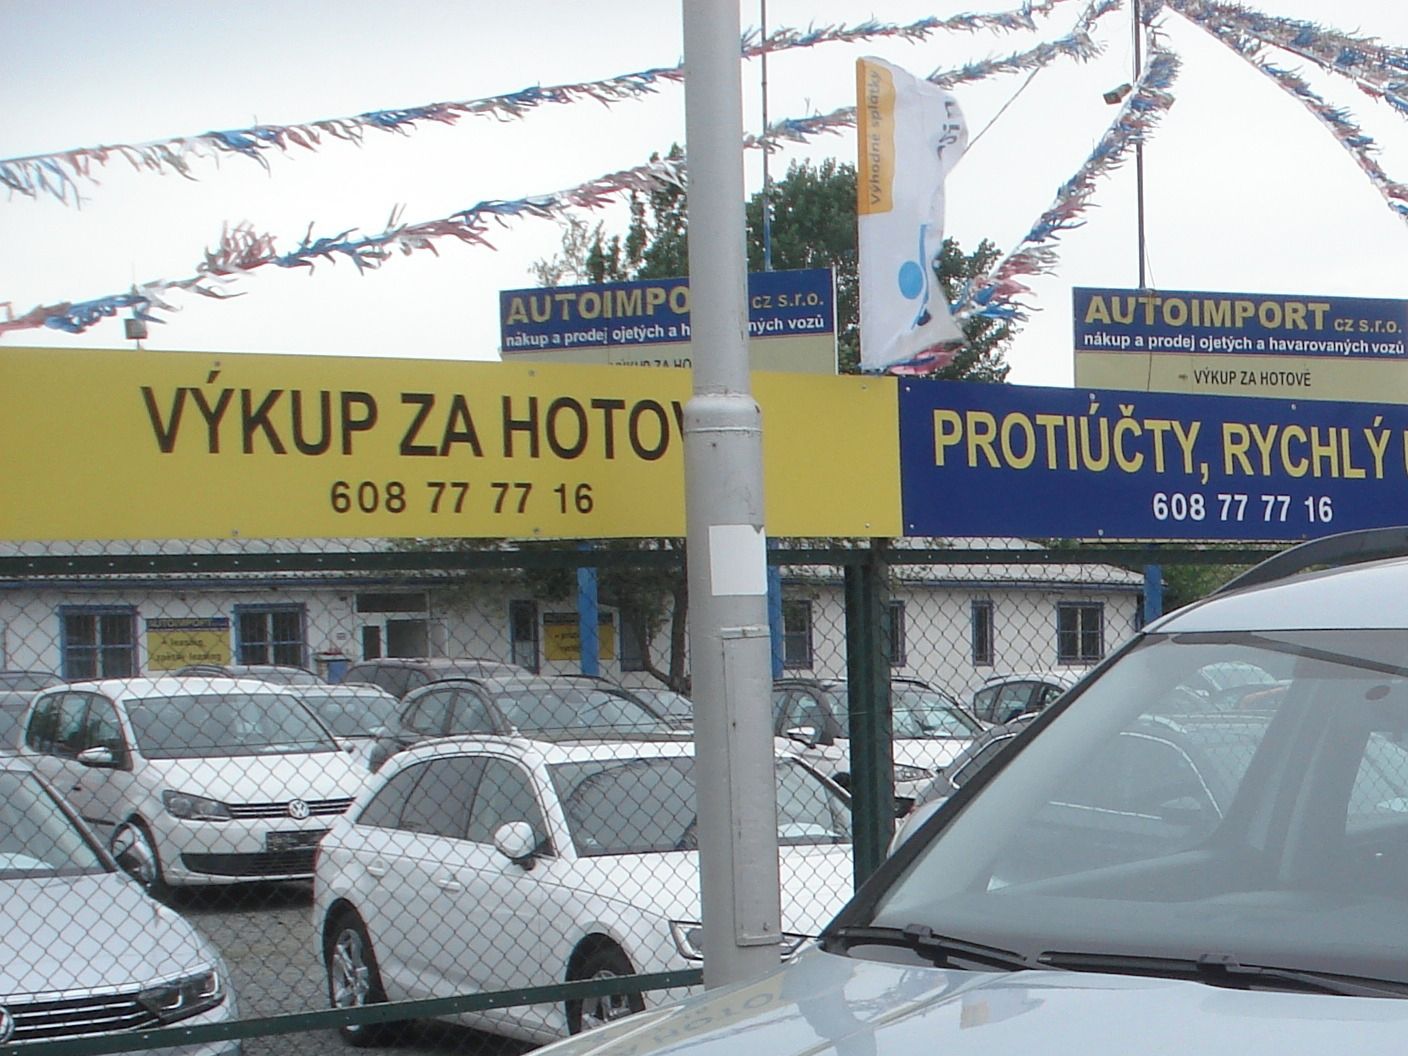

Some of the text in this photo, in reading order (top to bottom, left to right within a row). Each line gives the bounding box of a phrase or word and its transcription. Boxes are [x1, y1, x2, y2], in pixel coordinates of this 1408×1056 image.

[507, 285, 825, 325] AUTOIMPO cz s.r.o.
[1084, 295, 1403, 334] AUTOIMPORT cz s.r.o.
[506, 330, 549, 349] nákup
[552, 332, 560, 345] a
[564, 328, 608, 346] prodej
[612, 323, 664, 342] ojetých
[668, 326, 678, 338] a
[1084, 332, 1404, 357] nákup a prodej ojetých a havarovaných vozů
[1194, 366, 1236, 385] VÝKUP
[1240, 370, 1257, 386] ZA
[140, 370, 684, 461] VÝKUP ZA HOTO
[933, 402, 1208, 484] PROTIÚČTY,
[1223, 415, 1391, 480] RYCHLÝ
[330, 480, 594, 514] 608 77 77 16
[1152, 493, 1334, 523] 608 77 77 16
